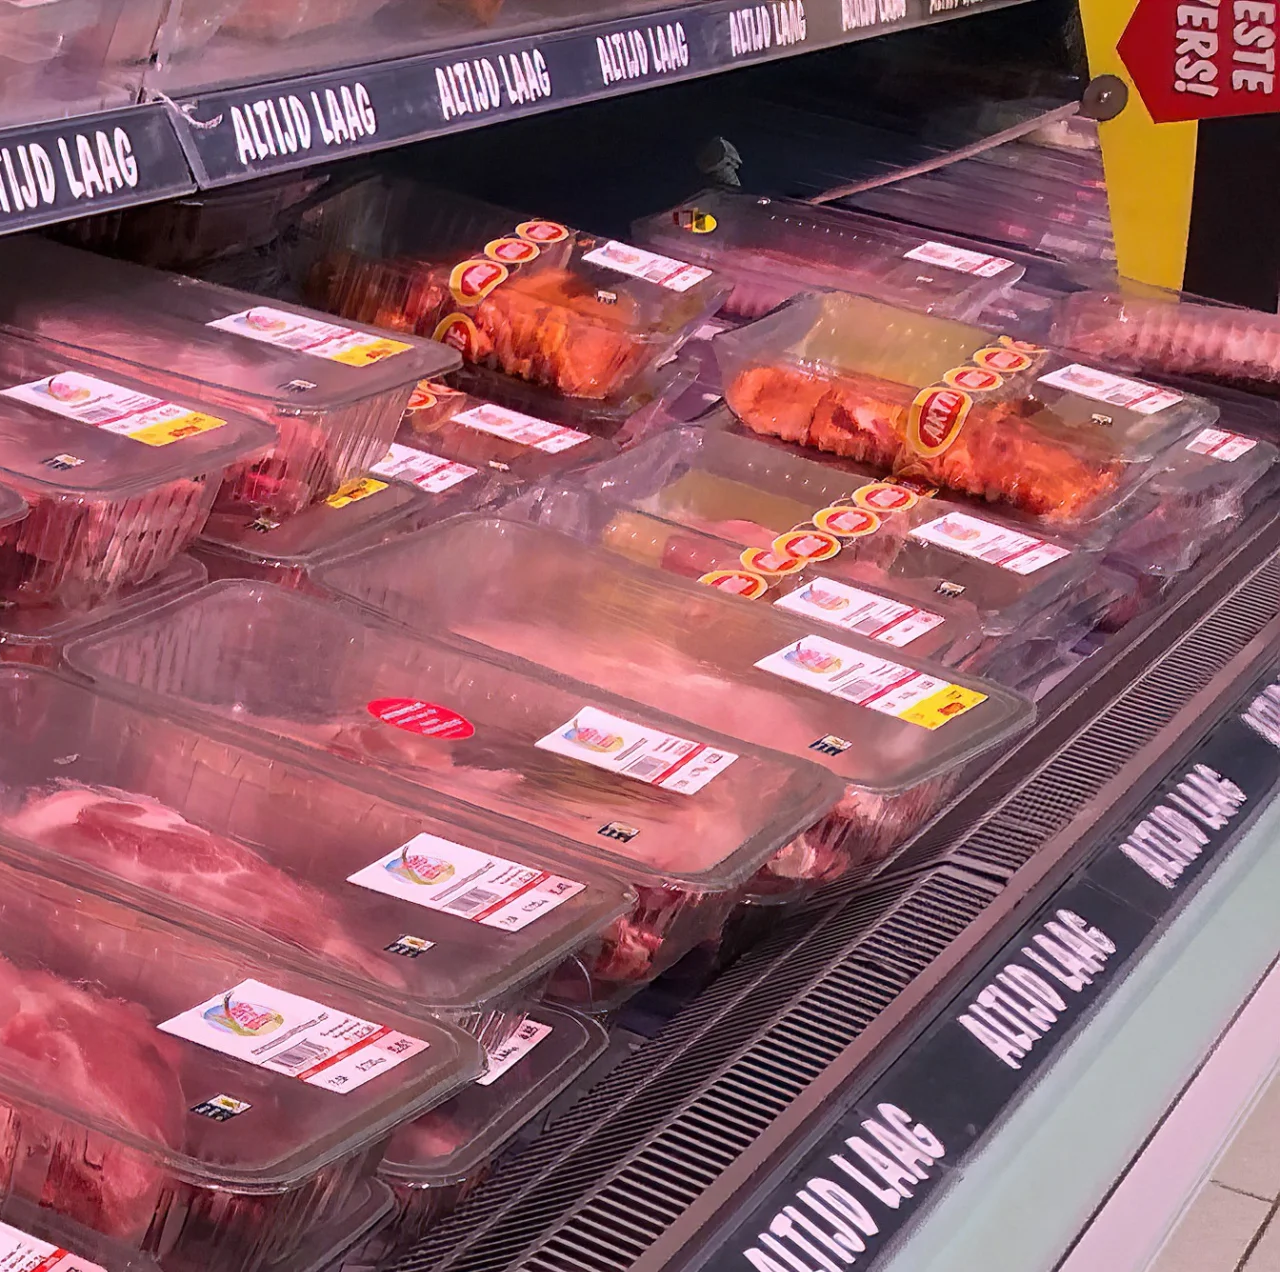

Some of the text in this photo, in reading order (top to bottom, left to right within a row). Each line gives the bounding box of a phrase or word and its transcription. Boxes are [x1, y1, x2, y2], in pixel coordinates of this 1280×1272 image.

[595, 21, 690, 86] ALTIJD LAAG
[729, 0, 806, 57] ALTIJD LAAG
[1174, 0, 1219, 97] ERS!
[230, 82, 376, 166] ALTIJD LAAG
[434, 48, 552, 120] ALTIJD LAAG
[57, 126, 139, 199] LAAG
[1118, 763, 1247, 889] ALTIJD LAAG
[956, 908, 1116, 1070] ALTIJD LAAG
[828, 1102, 945, 1209] LAAG
